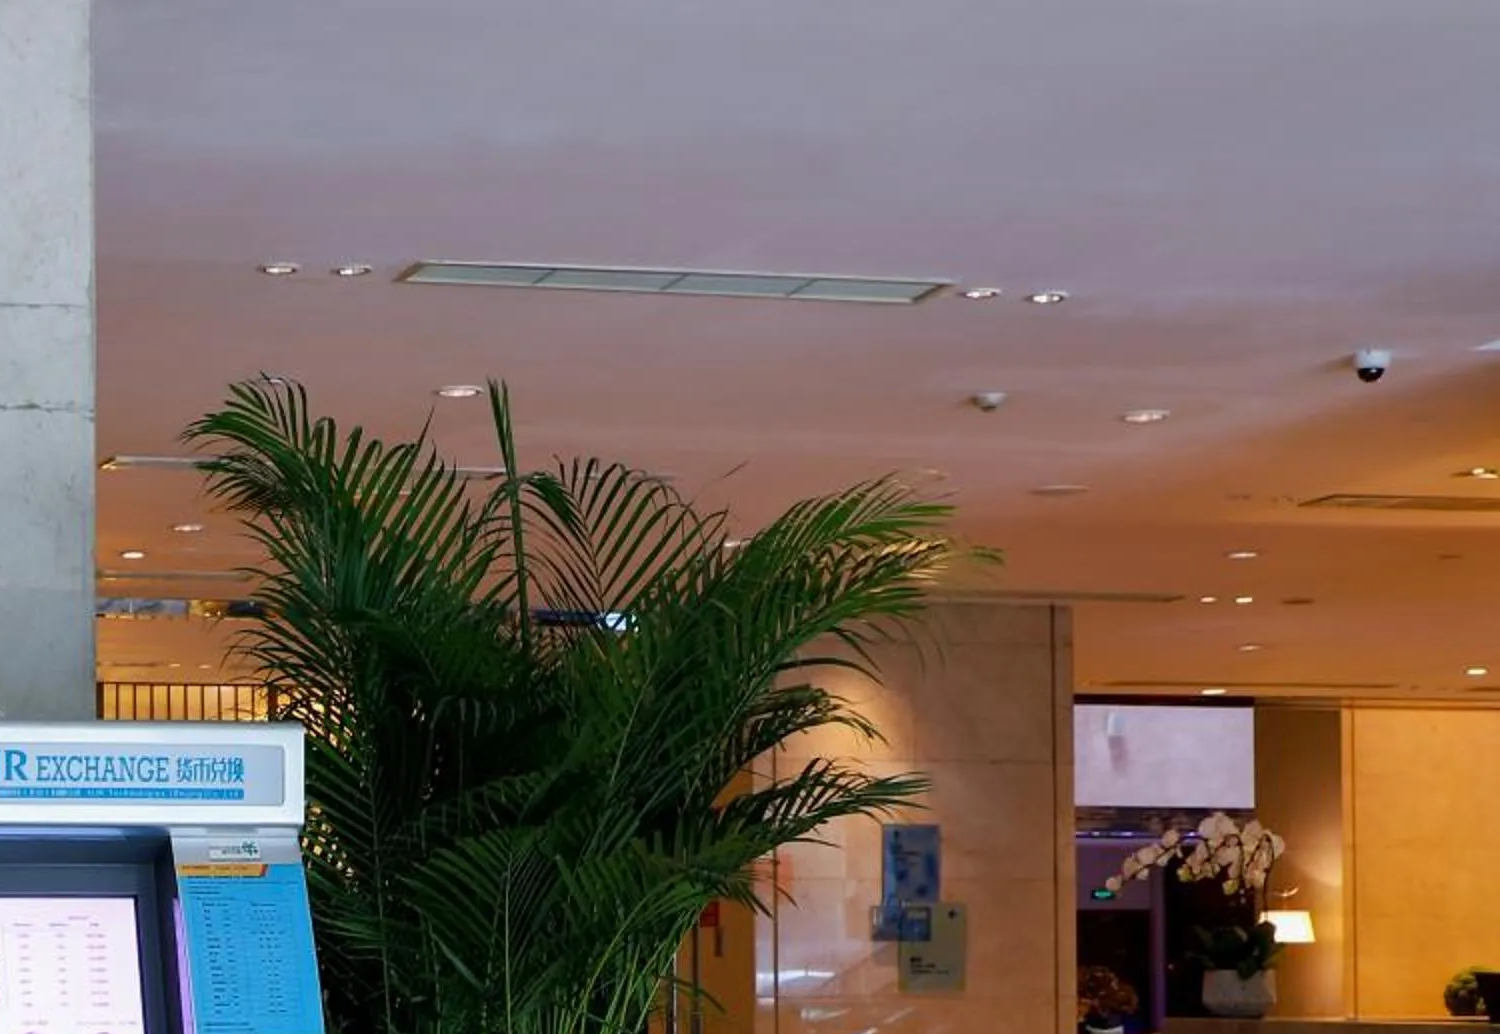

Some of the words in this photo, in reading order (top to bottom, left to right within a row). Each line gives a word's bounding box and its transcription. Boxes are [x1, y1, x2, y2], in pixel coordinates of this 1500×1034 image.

[35, 755, 170, 783] EXCHANGE
[175, 756, 245, 785] 货币兑换
